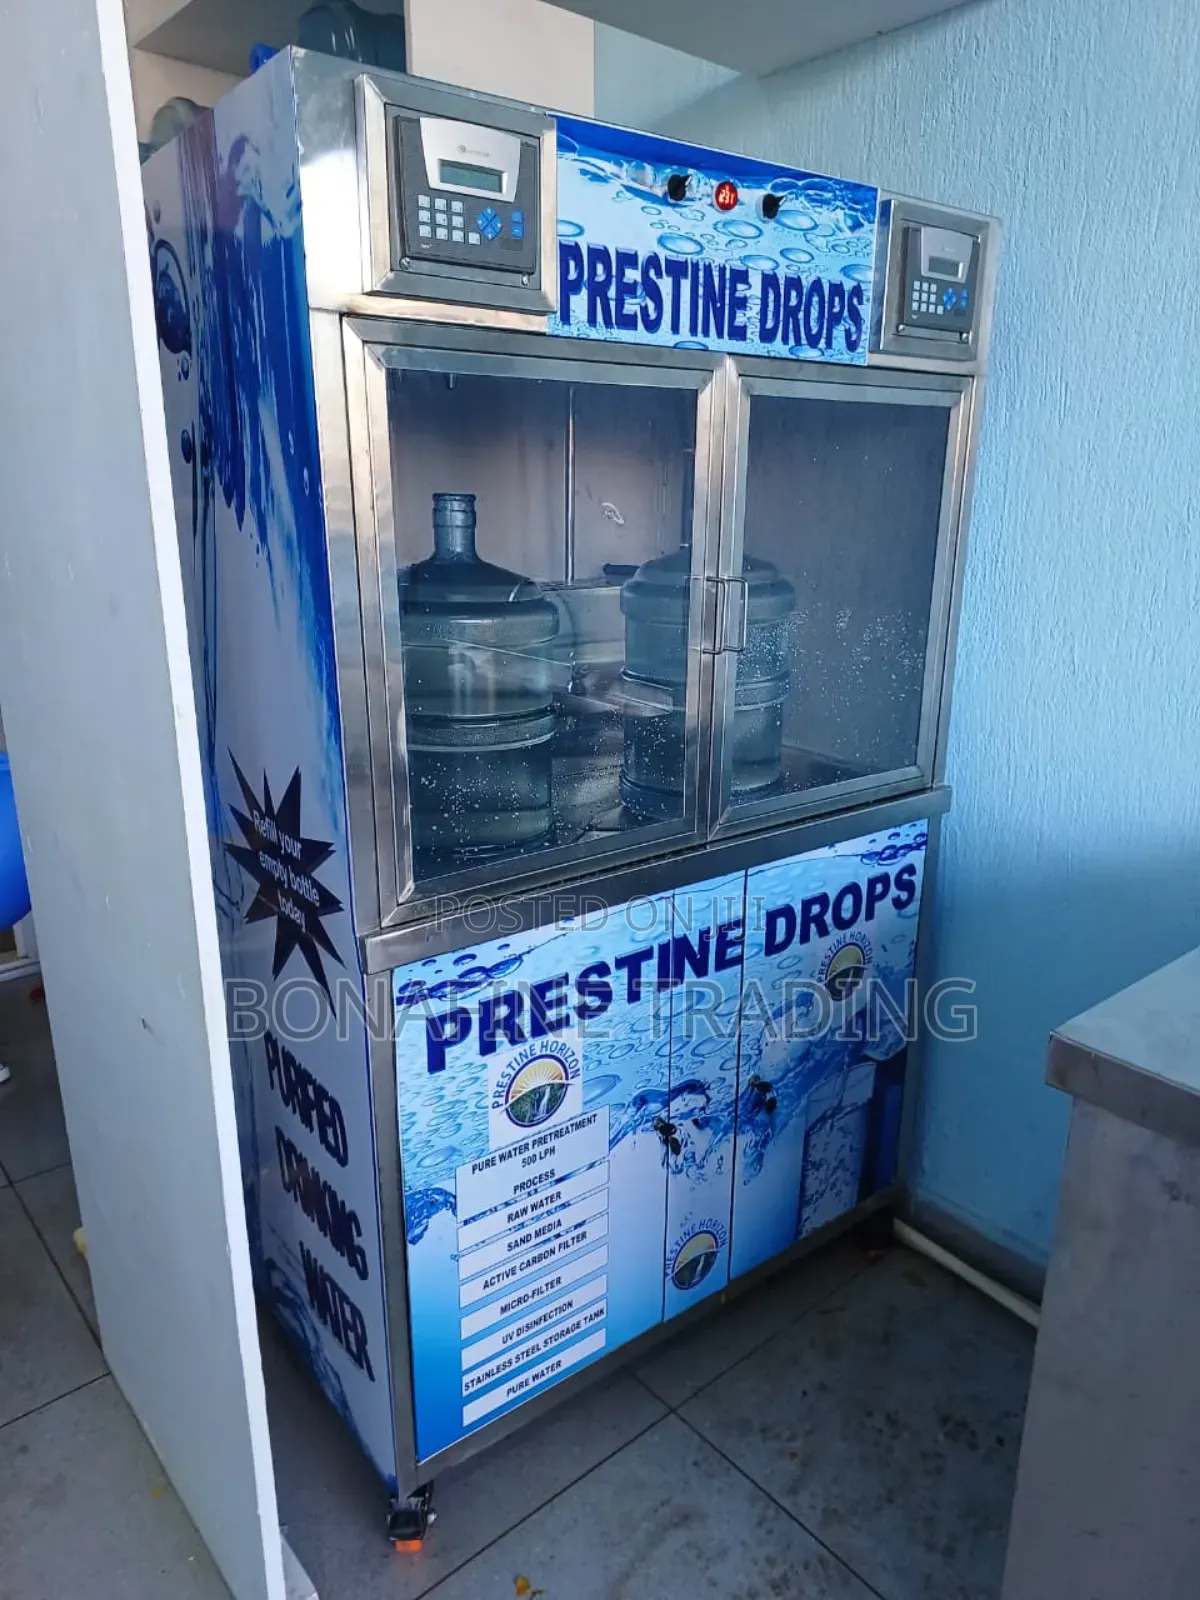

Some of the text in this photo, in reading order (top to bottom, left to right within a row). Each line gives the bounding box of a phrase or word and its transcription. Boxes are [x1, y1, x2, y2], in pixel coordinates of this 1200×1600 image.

[559, 240, 864, 352] PRESTINE DROPS
[253, 810, 302, 861] Refill your
[259, 851, 320, 907] empty bottle
[277, 888, 306, 932] today
[425, 864, 917, 1074] PRESTINE DROPS
[491, 1039, 581, 1109] PRESTINE HORIZON
[472, 1113, 598, 1175] PURE WATER PRETREATMENT
[521, 1146, 556, 1168] 500 LPH
[507, 1191, 562, 1223] RAW WATER
[513, 1169, 556, 1195] PROCESS
[483, 1230, 588, 1290] ACTIVE CARBON FILTER
[507, 1218, 562, 1252] SAND MEDIA
[299, 1240, 376, 1382] WATER
[500, 1276, 562, 1315] MICRO-FILTER
[502, 1300, 574, 1345] UV DISINFECTION
[464, 1308, 605, 1391] STAINLESS STEEL STORAGE TANK
[507, 1360, 562, 1397] PURE WATER
